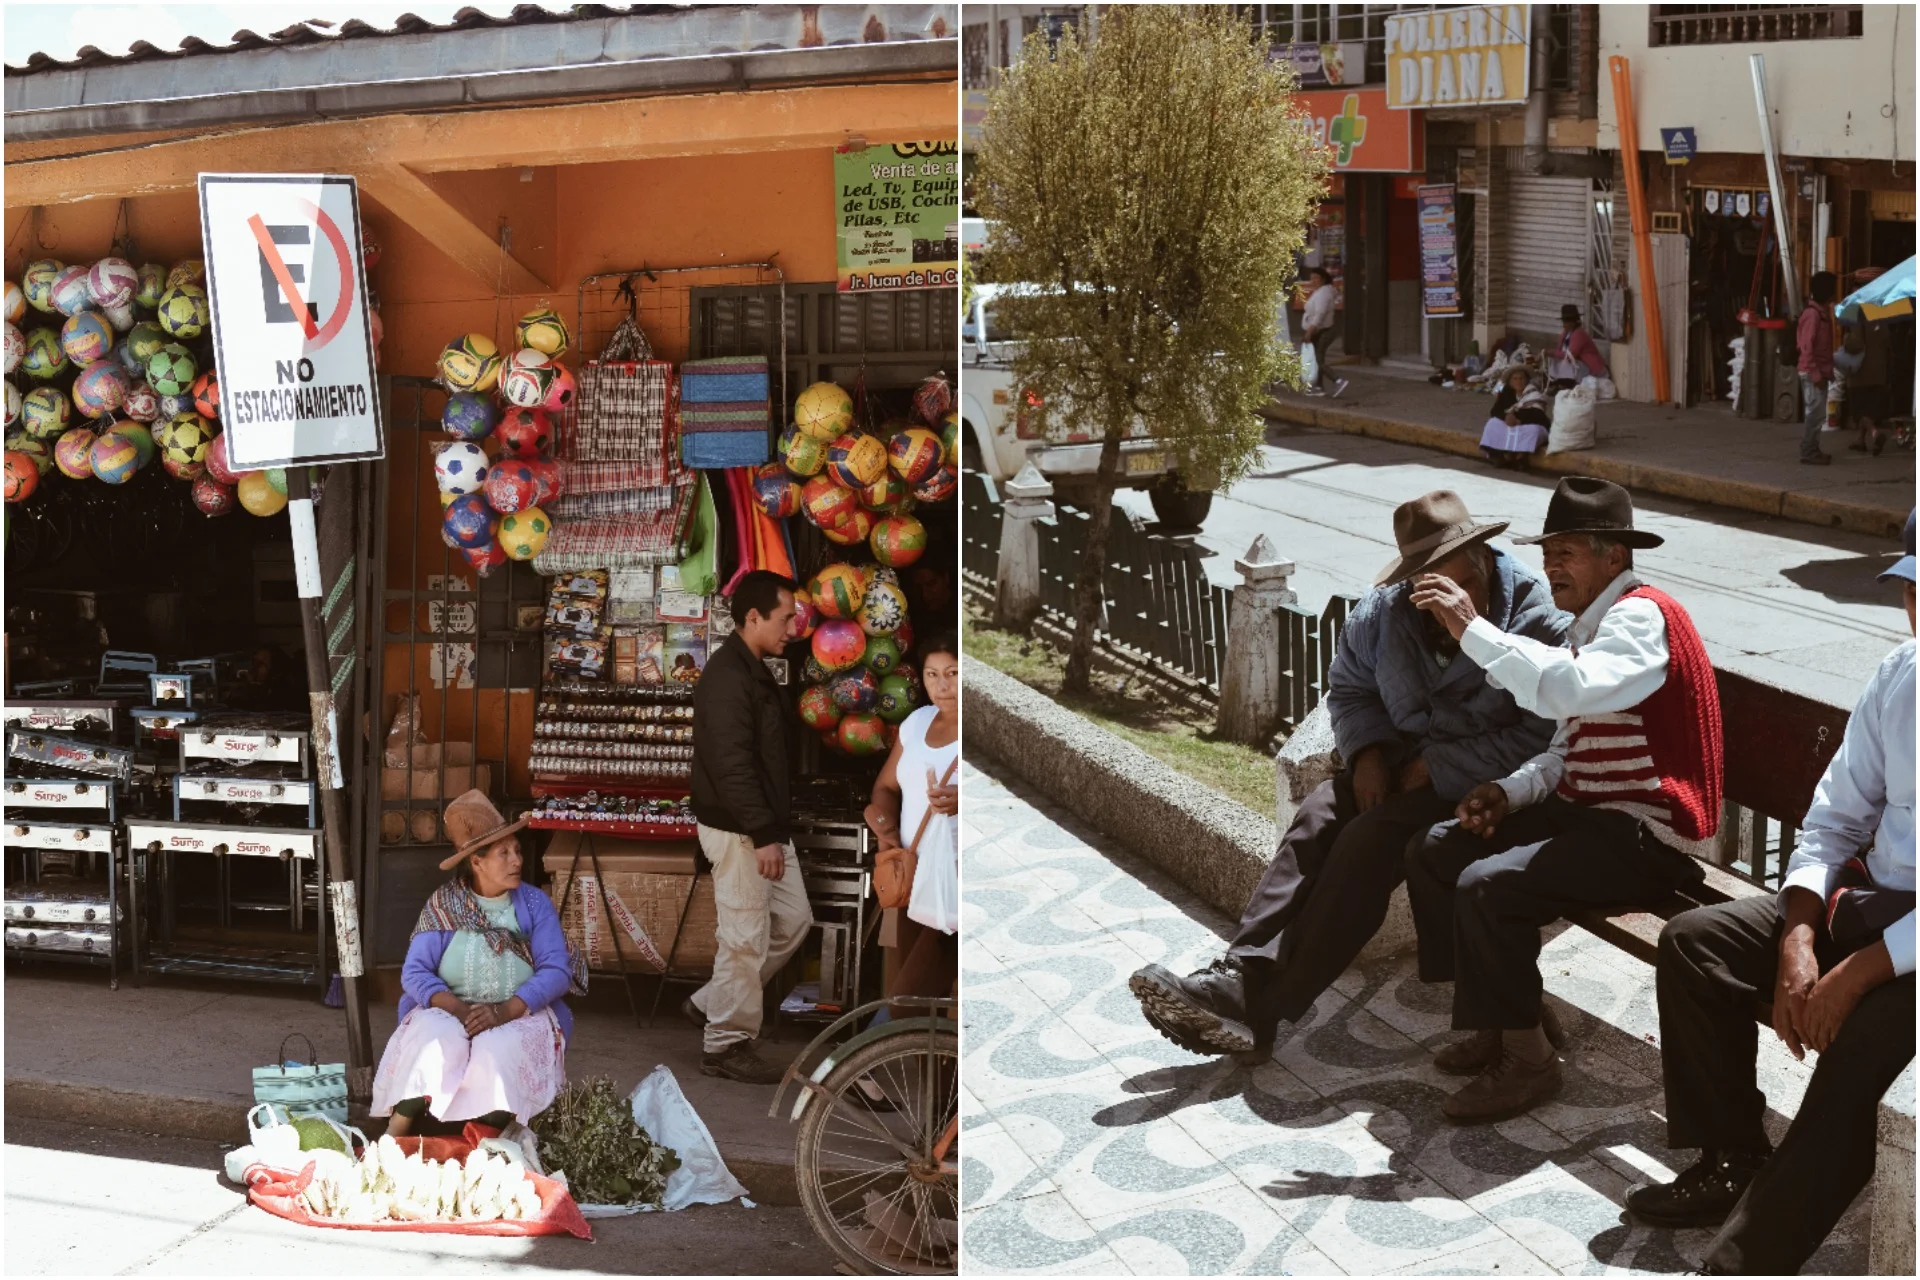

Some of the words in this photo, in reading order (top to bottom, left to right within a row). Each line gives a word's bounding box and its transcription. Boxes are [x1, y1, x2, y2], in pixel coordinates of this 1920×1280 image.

[1384, 5, 1525, 55] POLLERIA
[1400, 50, 1505, 104] DIANA
[870, 162, 916, 180] Venta
[920, 159, 940, 176] de
[842, 182, 877, 198] Led,
[883, 180, 906, 196] Tv,
[843, 200, 864, 213] de
[868, 196, 905, 212] USB,
[844, 213, 888, 228] Pilas,
[893, 211, 921, 226] Etc
[258, 225, 318, 324] E
[850, 274, 866, 289] Jr.
[868, 272, 902, 290] Juan
[905, 270, 925, 287] de
[927, 269, 942, 285] la
[275, 357, 315, 386] NO
[234, 383, 367, 424] ESTACIONAMIENTO
[53, 745, 88, 761] Surge
[224, 738, 259, 752] Surge
[34, 790, 68, 802] Surge
[227, 786, 263, 798] Surge
[171, 836, 205, 849] Surge
[236, 841, 271, 854] Surge
[607, 894, 636, 932] FRAGILE
